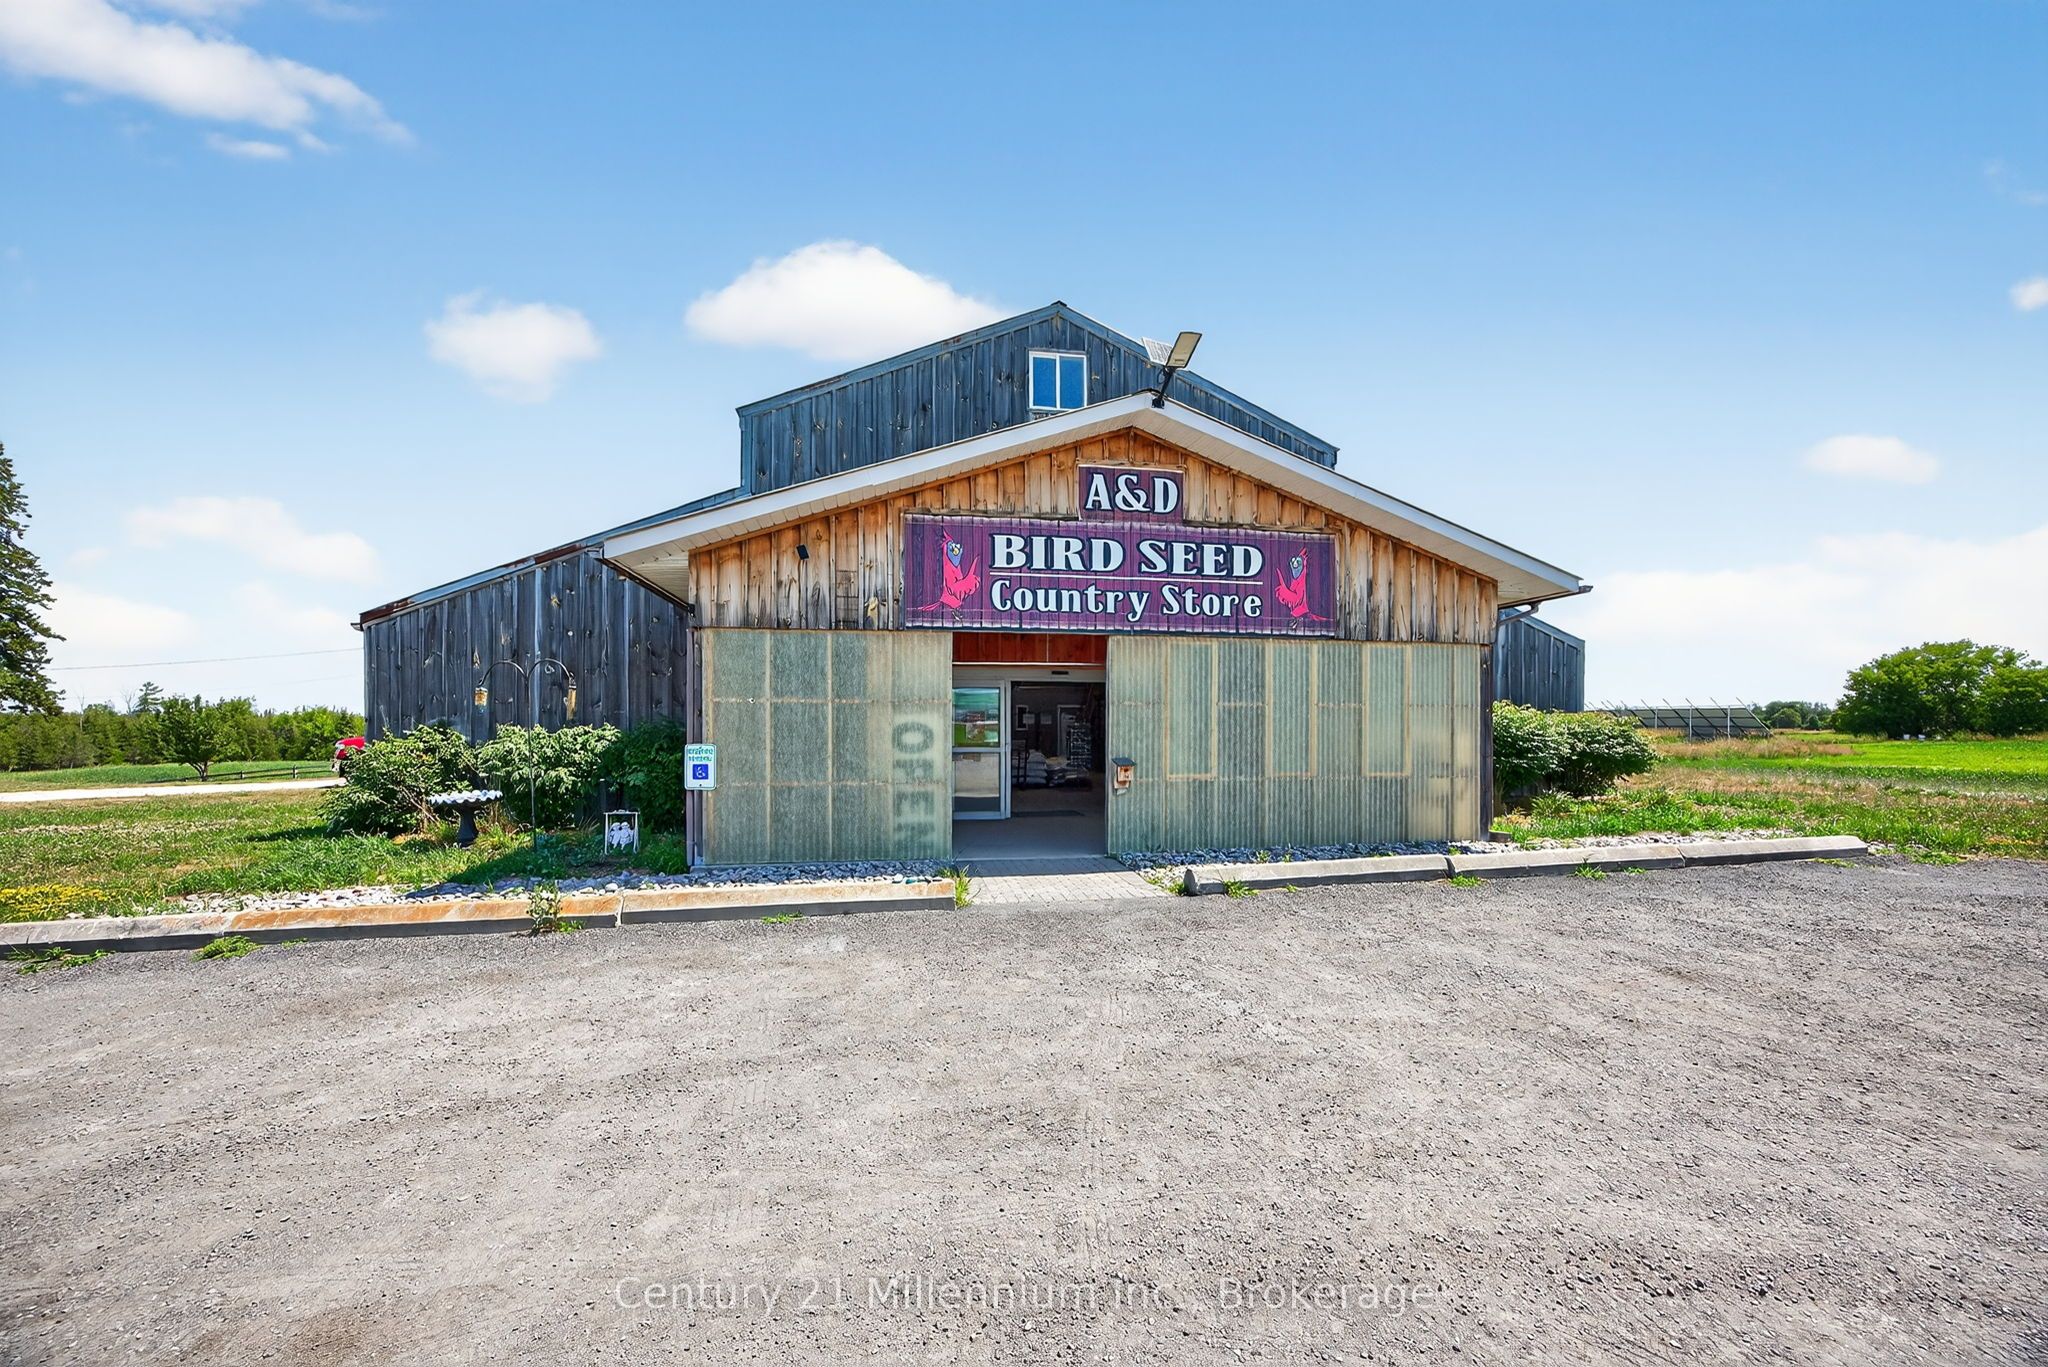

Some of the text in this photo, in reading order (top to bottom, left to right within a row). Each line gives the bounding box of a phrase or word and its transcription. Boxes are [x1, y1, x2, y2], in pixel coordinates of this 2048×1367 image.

[1085, 473, 1178, 513] A&D
[992, 534, 1263, 577] BIRD SEED
[991, 579, 1262, 622] Country Store
